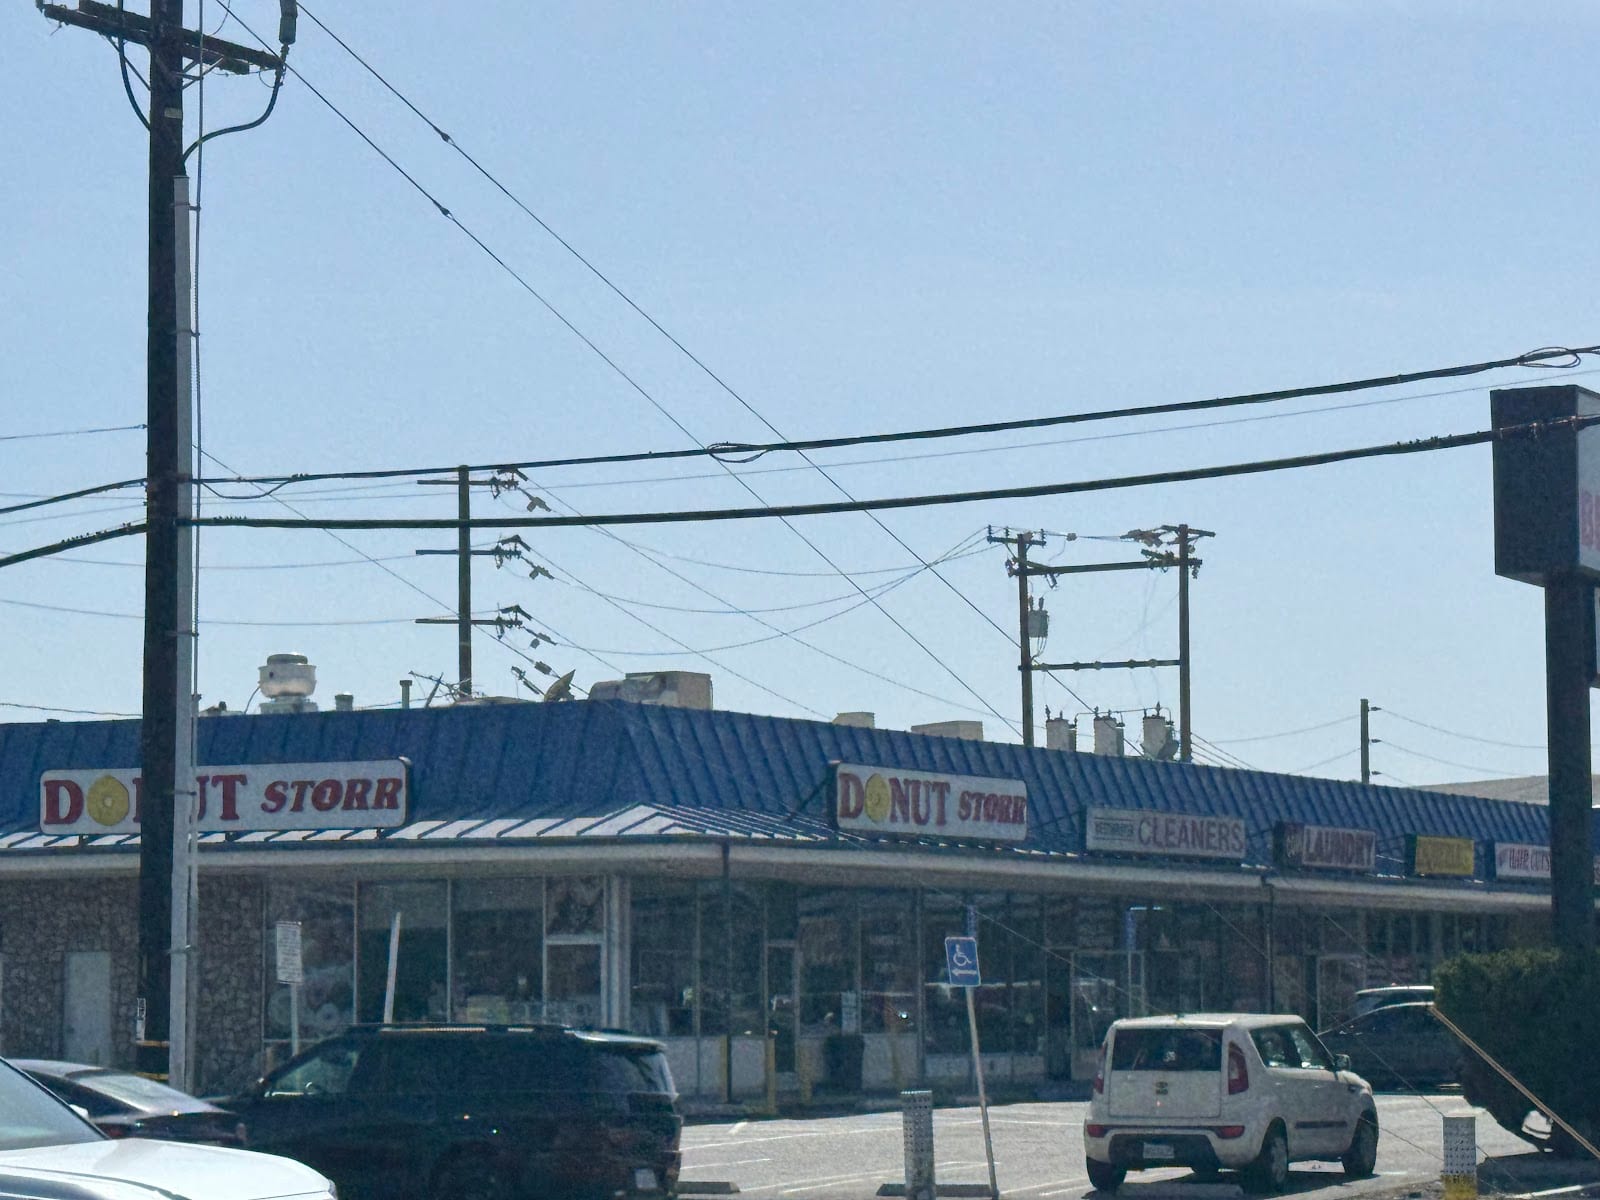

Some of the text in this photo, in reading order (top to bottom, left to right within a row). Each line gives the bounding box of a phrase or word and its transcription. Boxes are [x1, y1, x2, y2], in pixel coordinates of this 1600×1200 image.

[44, 774, 403, 826] DOT STORR
[839, 772, 951, 826] DONUT
[1137, 815, 1244, 853] CLEANERS
